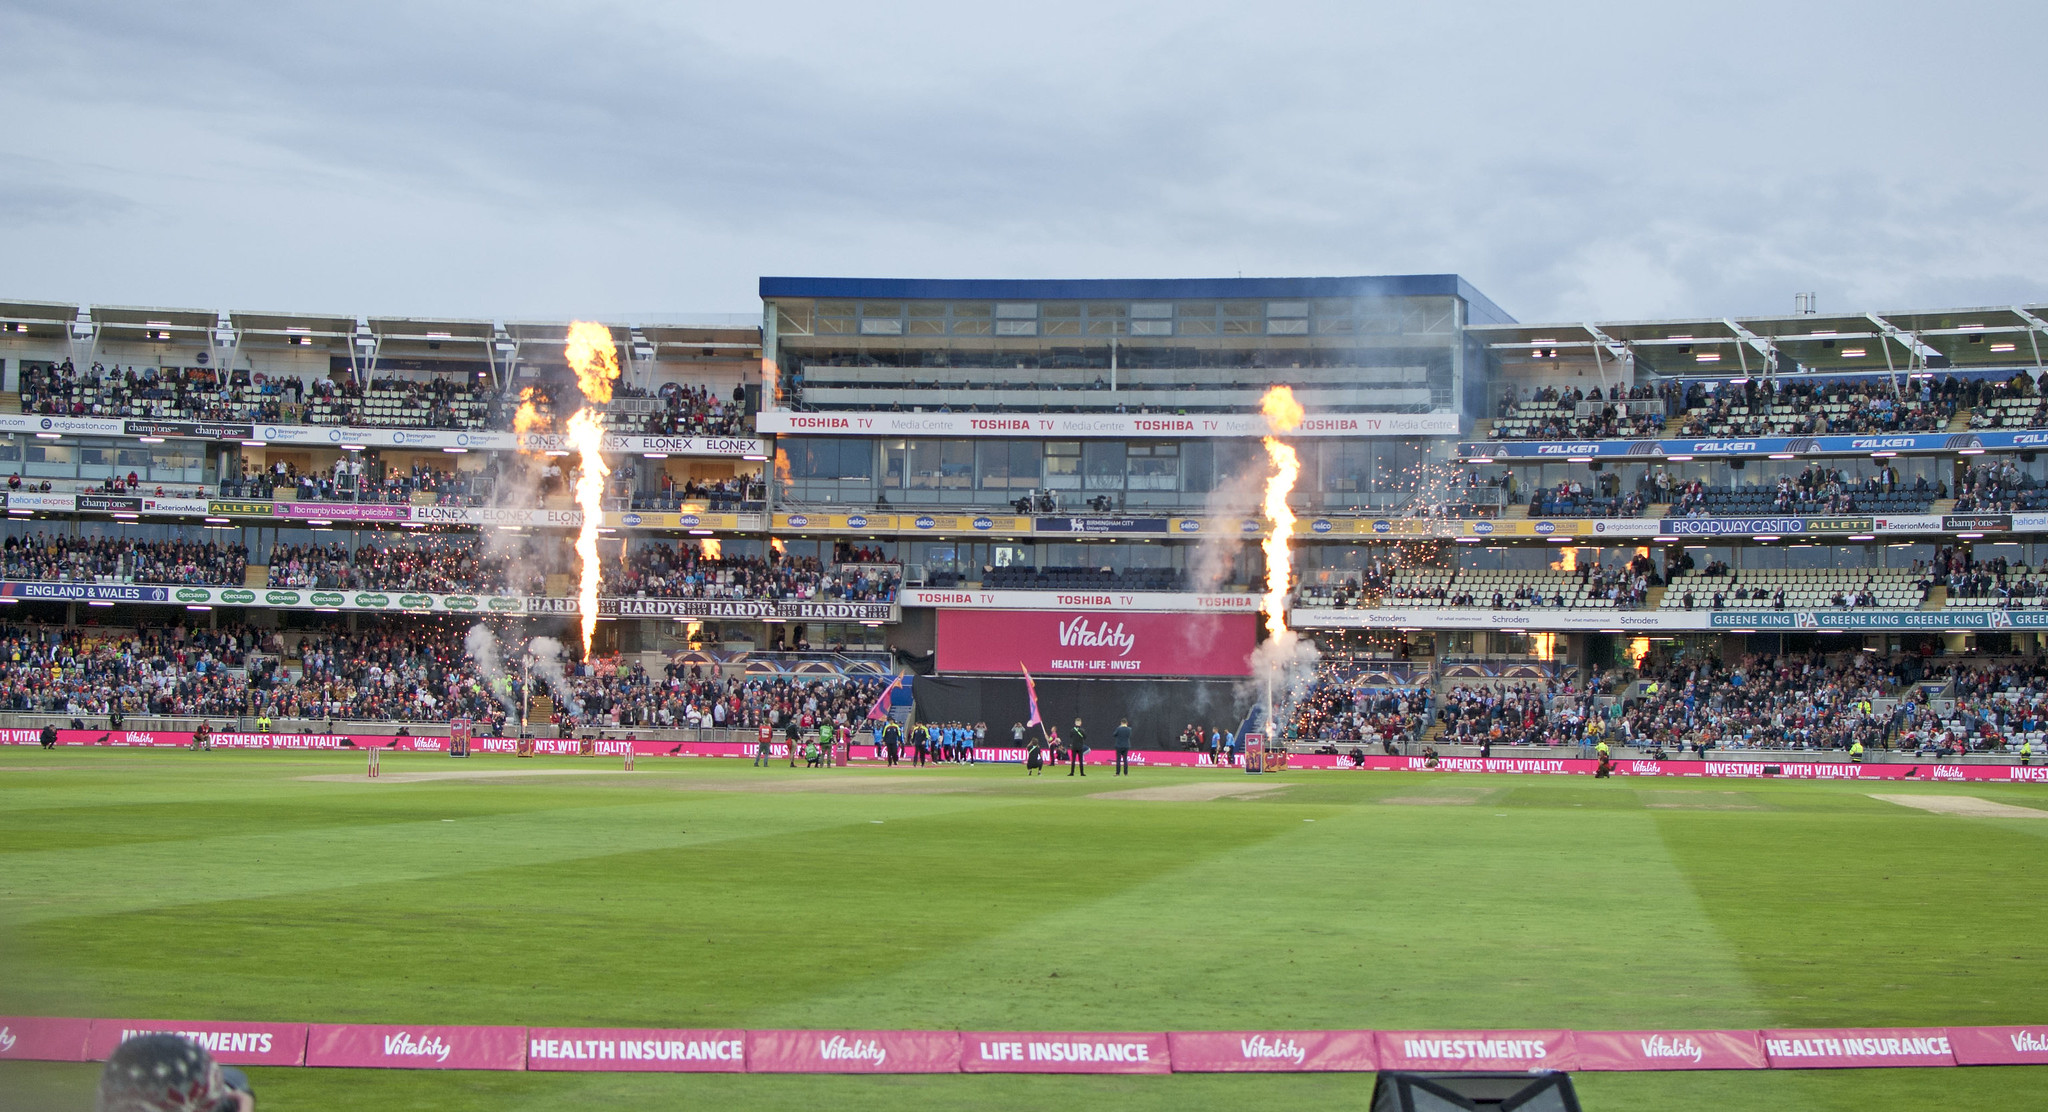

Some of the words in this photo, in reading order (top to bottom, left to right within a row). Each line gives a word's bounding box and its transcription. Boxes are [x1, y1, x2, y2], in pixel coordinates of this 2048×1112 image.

[54, 421, 118, 431] edgbaston.com
[789, 417, 849, 428] TOSHIBA
[857, 418, 873, 429] TV
[891, 419, 920, 430] Media
[922, 419, 954, 430] Centre
[970, 419, 1030, 430] TOSHIBA
[1039, 420, 1055, 430] TV
[1062, 420, 1092, 430] Media
[1093, 421, 1125, 431] Centre
[1134, 420, 1194, 431] TOSHIBA
[1202, 420, 1219, 430] TV
[1299, 419, 1358, 430] TOSHIBA
[1366, 420, 1382, 430] TV
[1389, 420, 1418, 430] Media
[1420, 420, 1453, 430] Centre
[643, 438, 692, 449] ELONEX
[706, 439, 756, 450] ELONEX
[1693, 442, 1756, 452] FALKEN
[1851, 438, 1915, 448] FALKEN
[1537, 445, 1599, 454] FALKEN
[9, 496, 41, 505] national
[42, 498, 75, 508] express
[157, 503, 207, 513] ExterionMedia
[211, 504, 272, 513] ALLETT
[306, 507, 330, 517] manby
[361, 508, 394, 517] solicitors
[418, 508, 469, 519] ELONEX
[482, 509, 533, 521] ELONEX
[680, 516, 699, 524] selco
[788, 517, 807, 525] selco
[848, 518, 867, 526] selco
[916, 519, 935, 527] selco
[973, 520, 992, 528] selco
[1180, 522, 1200, 530] selco
[1312, 522, 1332, 530] selco
[1809, 521, 1870, 529] ALLETT
[1889, 522, 1940, 530] ExterionMedia
[2012, 517, 2046, 526] national
[1607, 523, 1658, 531] edgbaston.com
[1673, 520, 1751, 534] BROADWAY
[25, 585, 85, 597] ENGLAND
[87, 587, 96, 597] &
[98, 588, 140, 599] WALES
[178, 591, 208, 600] Specsavers
[223, 593, 253, 602] Specsavers
[268, 594, 298, 603] Specsavers
[313, 595, 342, 604] Specsavers
[917, 593, 972, 603] TOSHIBA
[980, 594, 995, 604] TV
[1057, 595, 1112, 605] TOSHIBA
[1119, 596, 1134, 605] TV
[1197, 597, 1252, 607] TOSHIBA
[528, 600, 577, 612] HARD
[620, 601, 686, 614] HARDYS
[710, 603, 776, 616] HARDYS
[801, 605, 867, 618] HARDYS
[1369, 614, 1407, 622] Schroders
[1492, 615, 1530, 624] Schroders
[1620, 616, 1658, 625] Schroders
[1714, 615, 1757, 625] GREENE
[1761, 615, 1790, 625] KING
[1794, 612, 1819, 628] IPA
[1821, 615, 1866, 625] GREENE
[1870, 615, 1899, 625] KING
[1905, 615, 1950, 625] GREENE
[1954, 615, 1983, 625] KING
[1986, 611, 2012, 628] IPA
[1059, 615, 1135, 657] Vitality
[1051, 659, 1085, 669] HEALTH
[1089, 660, 1106, 670] LIFE
[1111, 660, 1141, 670] INVEST
[12, 729, 41, 742] VITAL
[208, 734, 270, 746] VESTMENTS
[273, 735, 300, 747] WITH
[1486, 759, 1514, 771] WITH
[1517, 760, 1563, 771] VITALITY
[1783, 764, 1811, 775] WITH
[1815, 765, 1861, 776] VITALITY
[384, 1032, 451, 1062] Vitality
[531, 1039, 615, 1060] HEALTH
[620, 1040, 743, 1061] INSURANCE
[820, 1035, 885, 1066] Vitality
[980, 1041, 1024, 1061] LIFE
[1029, 1042, 1149, 1062] INSURANCE
[1241, 1034, 1305, 1065] Vitality
[1404, 1039, 1547, 1059] INVESTMENTS
[1641, 1034, 1703, 1063] Vitality
[1766, 1038, 1840, 1057] HEALTH
[1843, 1037, 1951, 1057] INSURANCE
